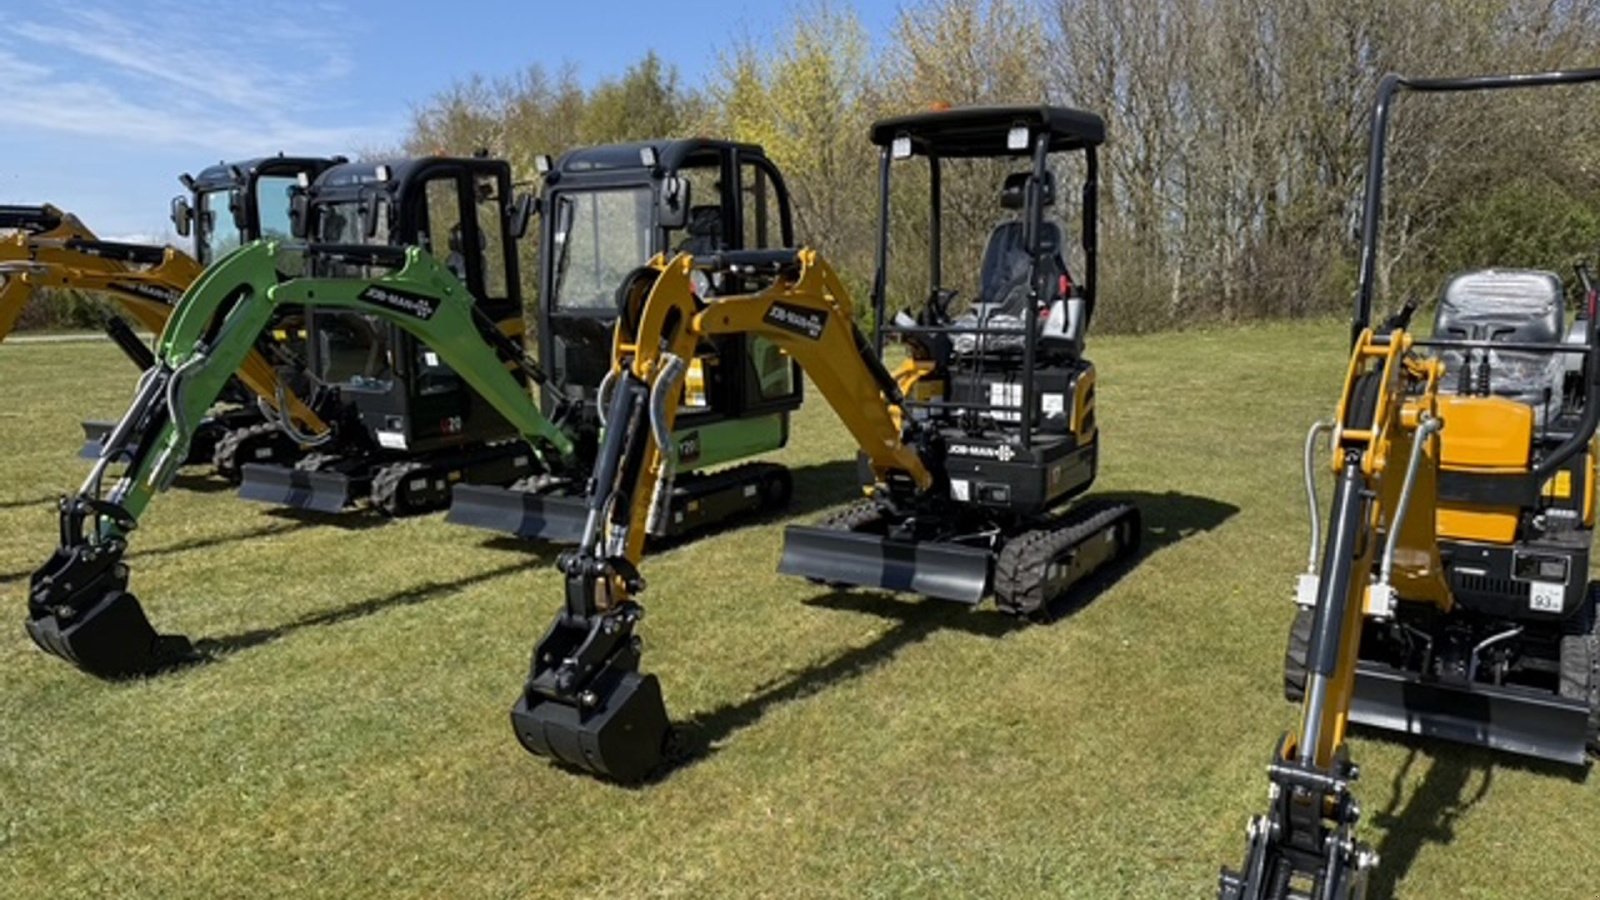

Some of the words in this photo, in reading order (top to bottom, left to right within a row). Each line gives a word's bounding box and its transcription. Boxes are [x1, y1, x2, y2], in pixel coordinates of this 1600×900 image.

[365, 287, 413, 310] JOB-MAN
[769, 305, 808, 329] JOB-MAN
[948, 444, 994, 457] JOB-MAN
[1534, 594, 1551, 608] 93
